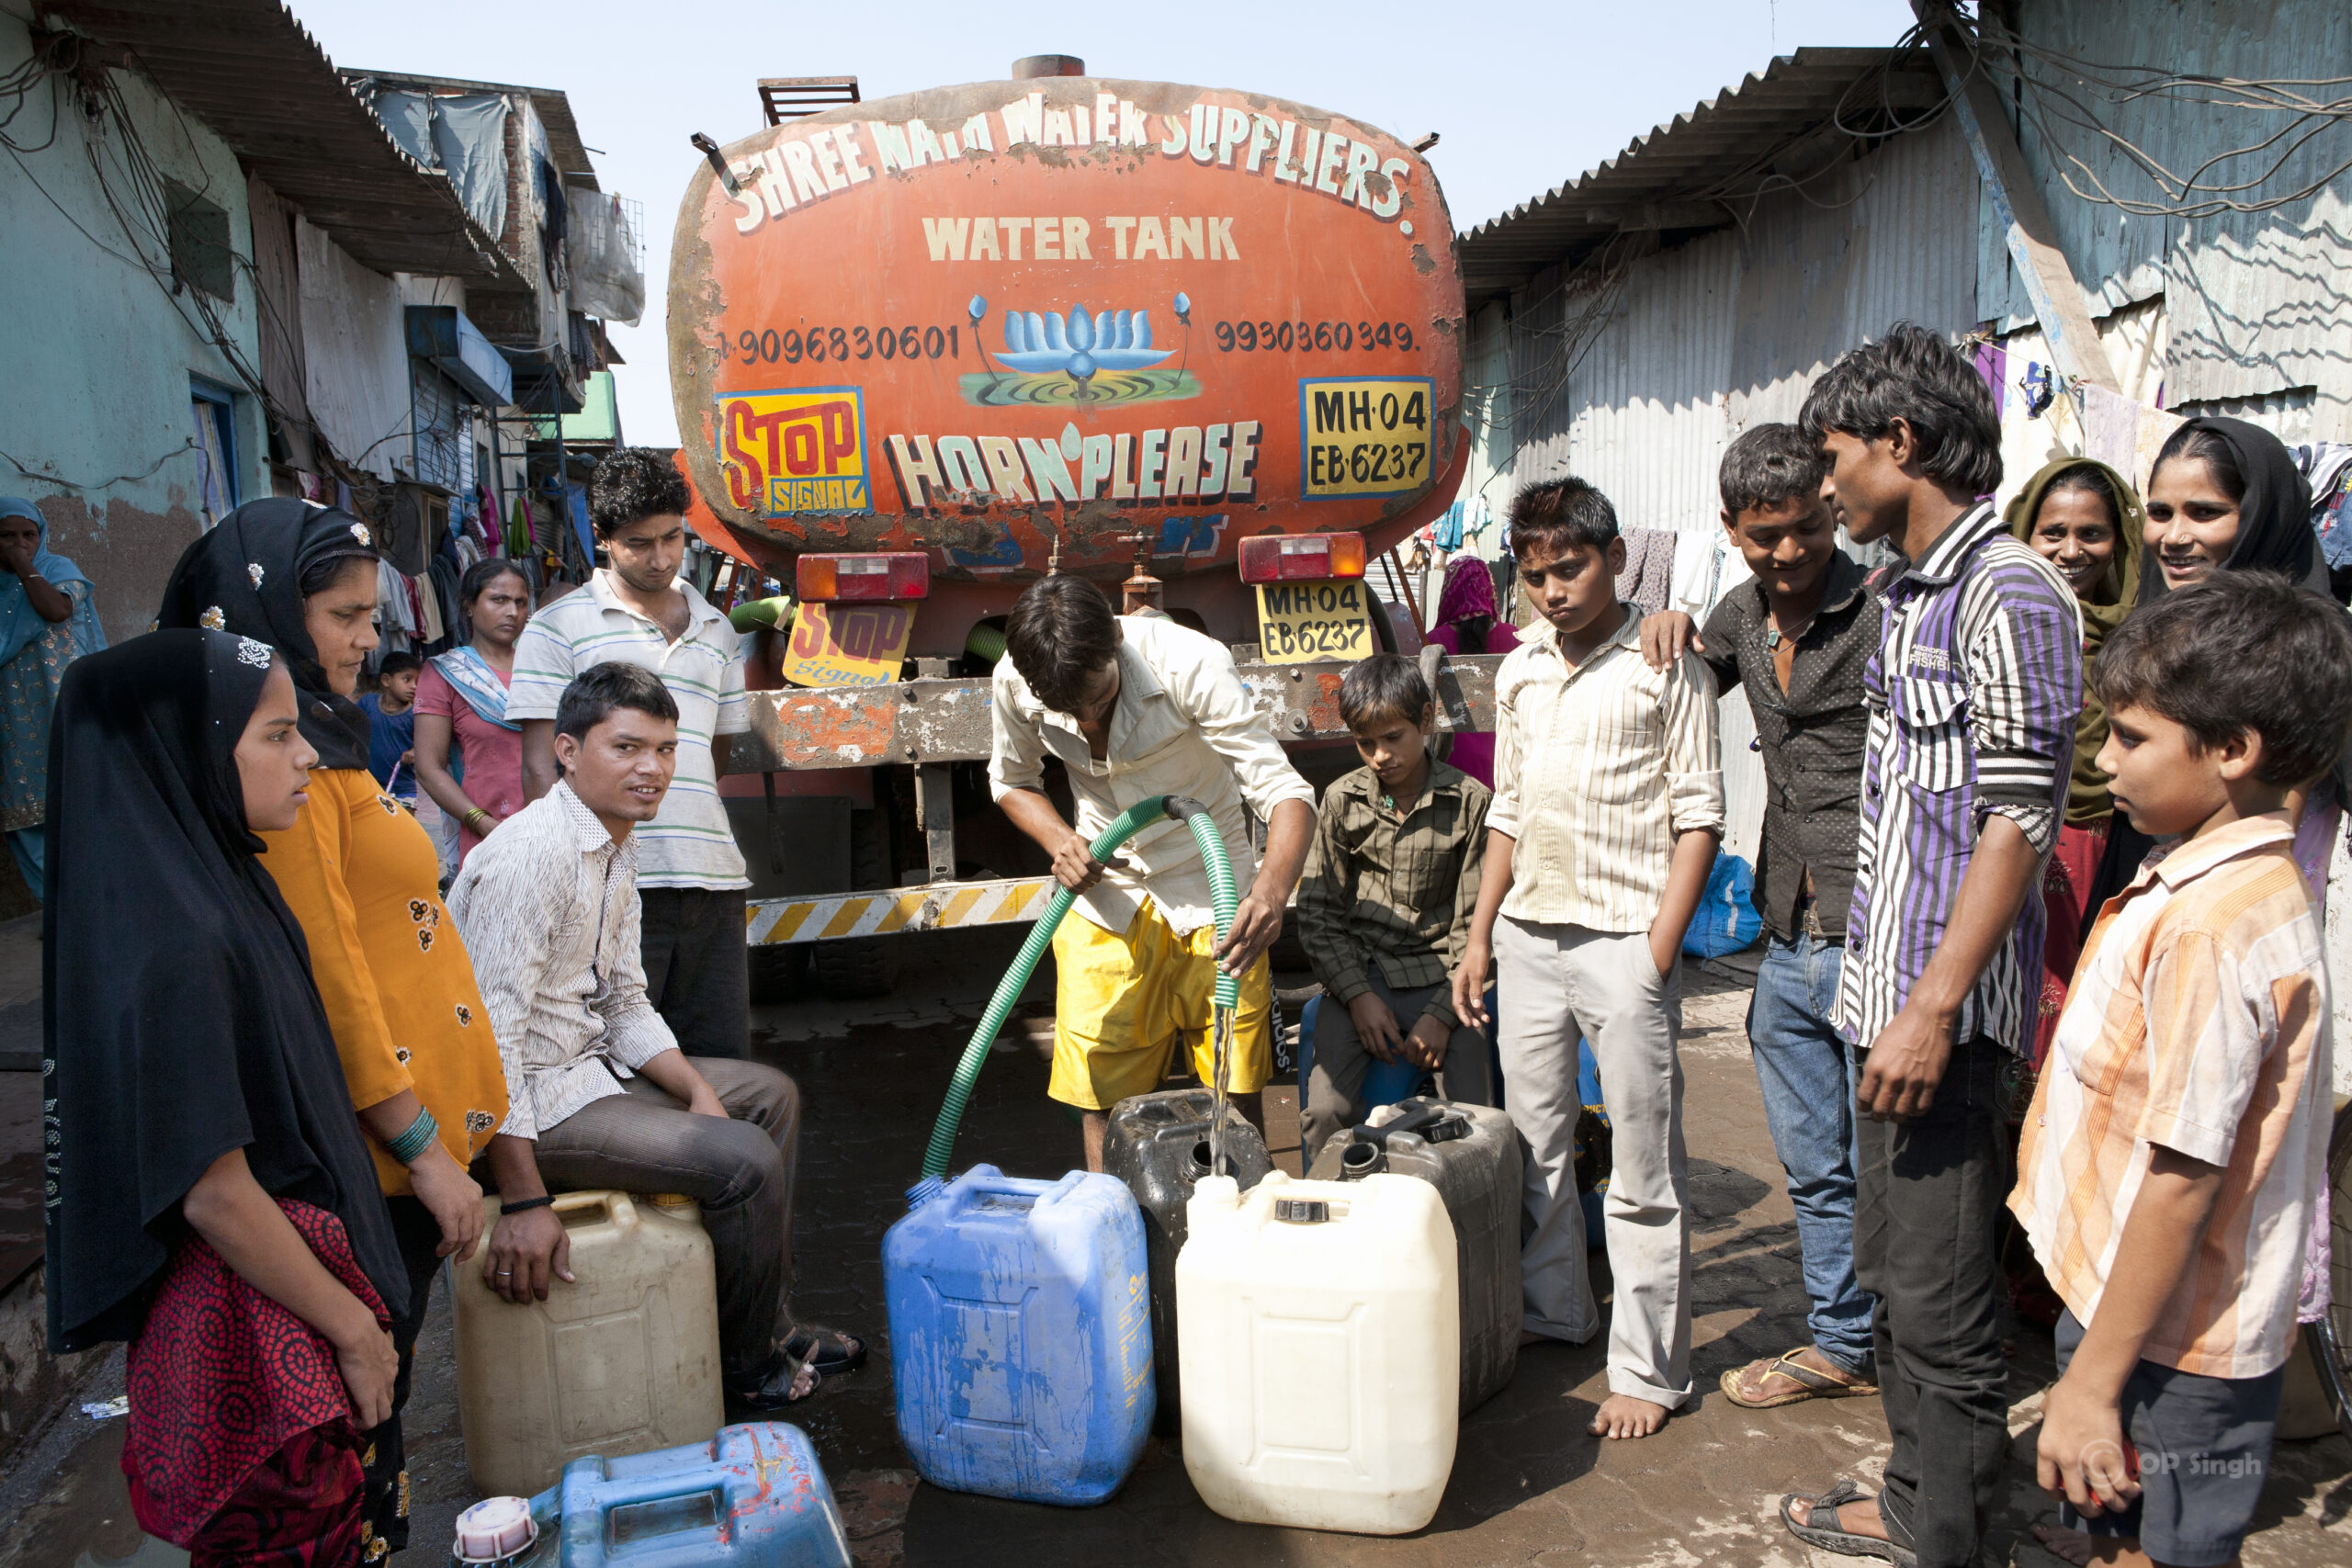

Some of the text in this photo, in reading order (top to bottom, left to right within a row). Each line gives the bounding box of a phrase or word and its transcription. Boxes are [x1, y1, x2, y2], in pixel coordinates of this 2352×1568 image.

[721, 122, 874, 232] SHREE
[922, 216, 1240, 262] WATER TANK
[739, 325, 958, 366] 9096830601
[725, 400, 855, 512] STOP
[887, 420, 1260, 509] HORN PLEASE
[773, 479, 866, 512] SIGNAL
